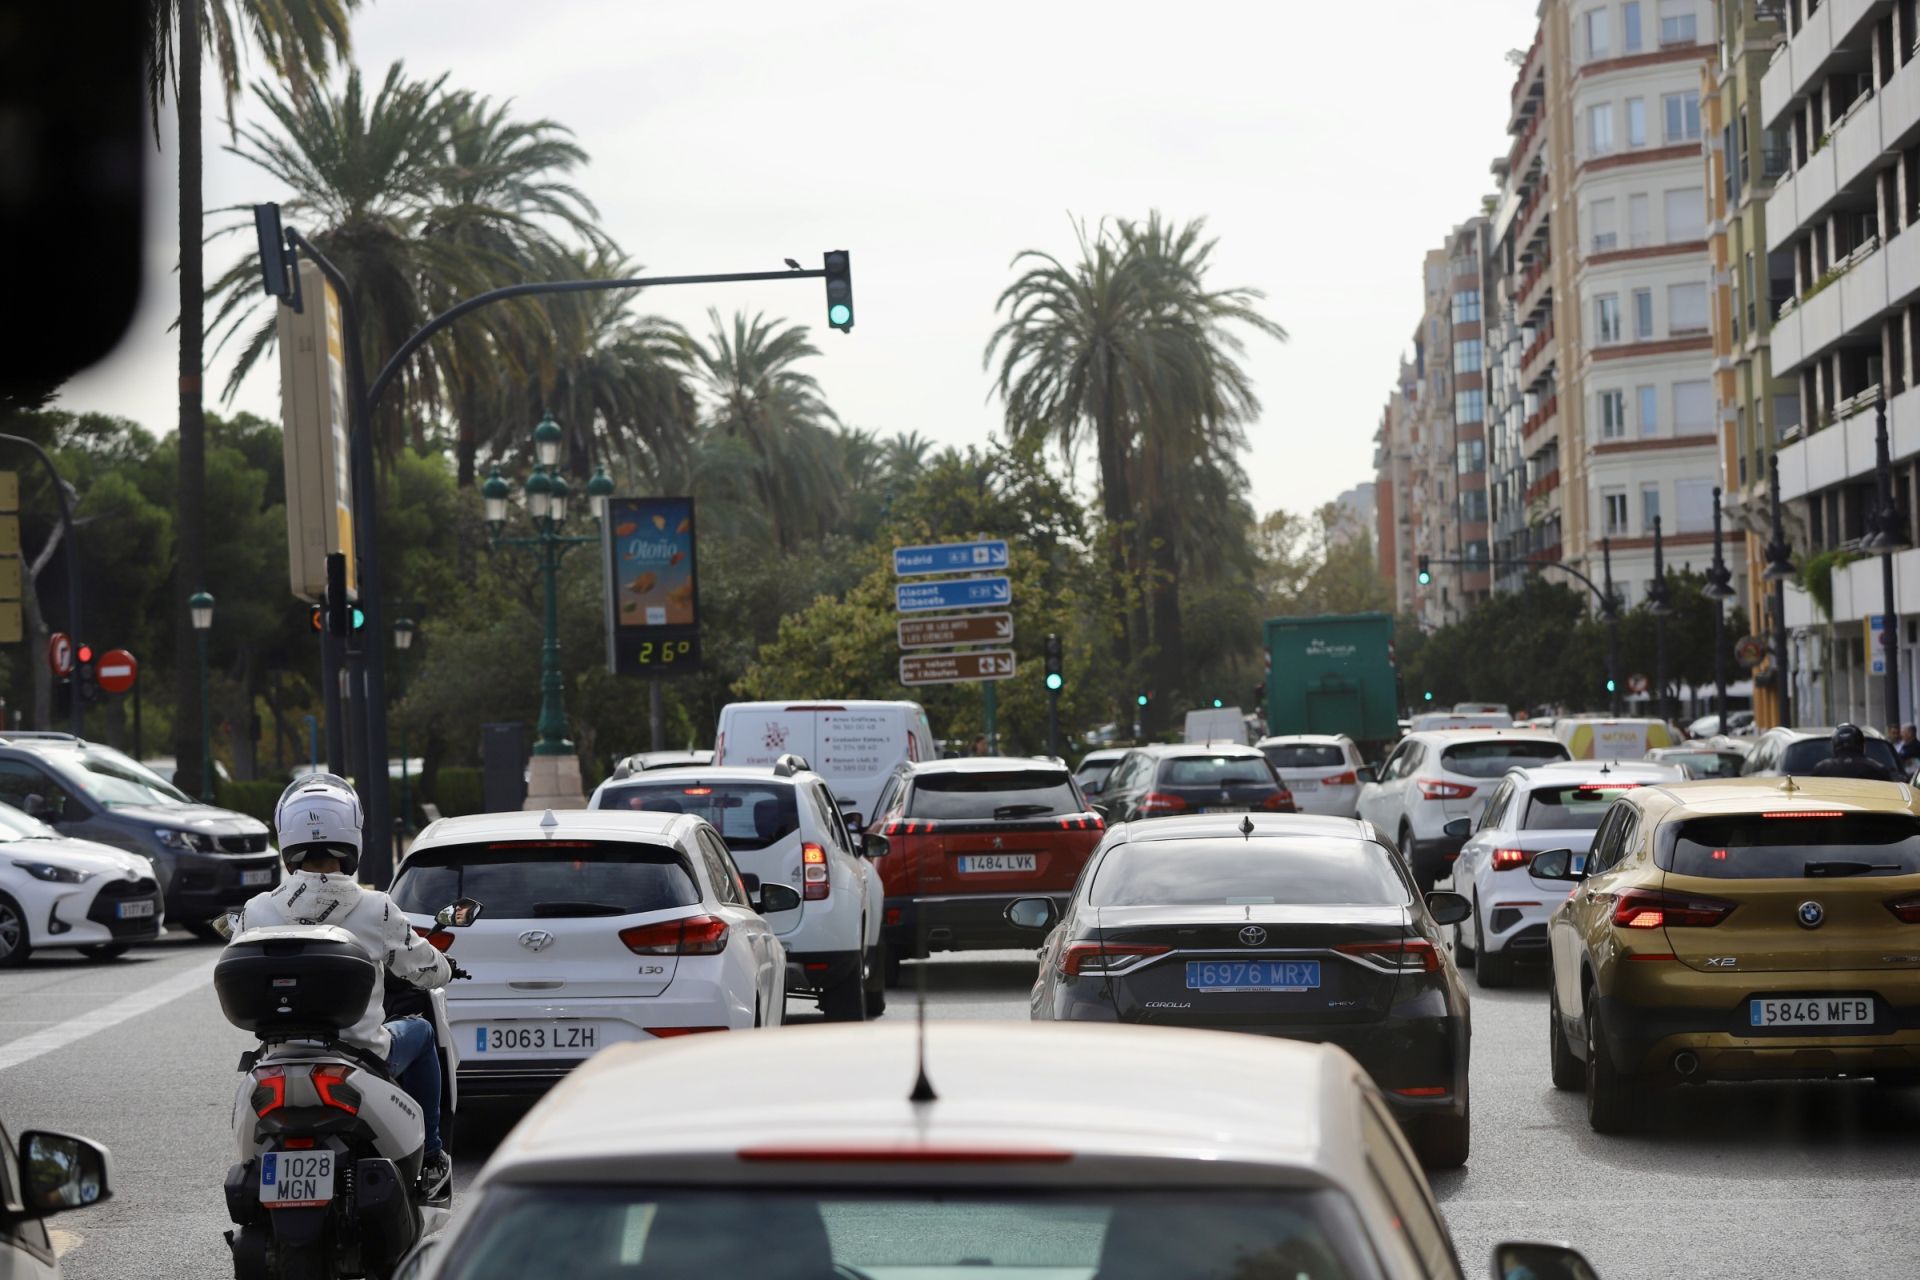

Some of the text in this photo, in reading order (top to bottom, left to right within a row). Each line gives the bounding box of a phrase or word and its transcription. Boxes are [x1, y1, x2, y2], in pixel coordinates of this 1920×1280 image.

[628, 538, 677, 560] Otoño
[897, 555, 933, 566] Madrid
[900, 586, 939, 597] Alacant
[900, 597, 945, 607] Albacete
[971, 856, 1032, 870] 1484 LVK
[1706, 957, 1737, 966] X2
[1203, 964, 1314, 985] 6976 MRX
[1765, 1003, 1820, 1022] 5846
[1828, 1002, 1868, 1021] MFB
[492, 1029, 545, 1049] 3063
[553, 1028, 594, 1048] LZH
[266, 1172, 272, 1180] E
[285, 1157, 330, 1178] 1028
[277, 1179, 316, 1200] MGN
